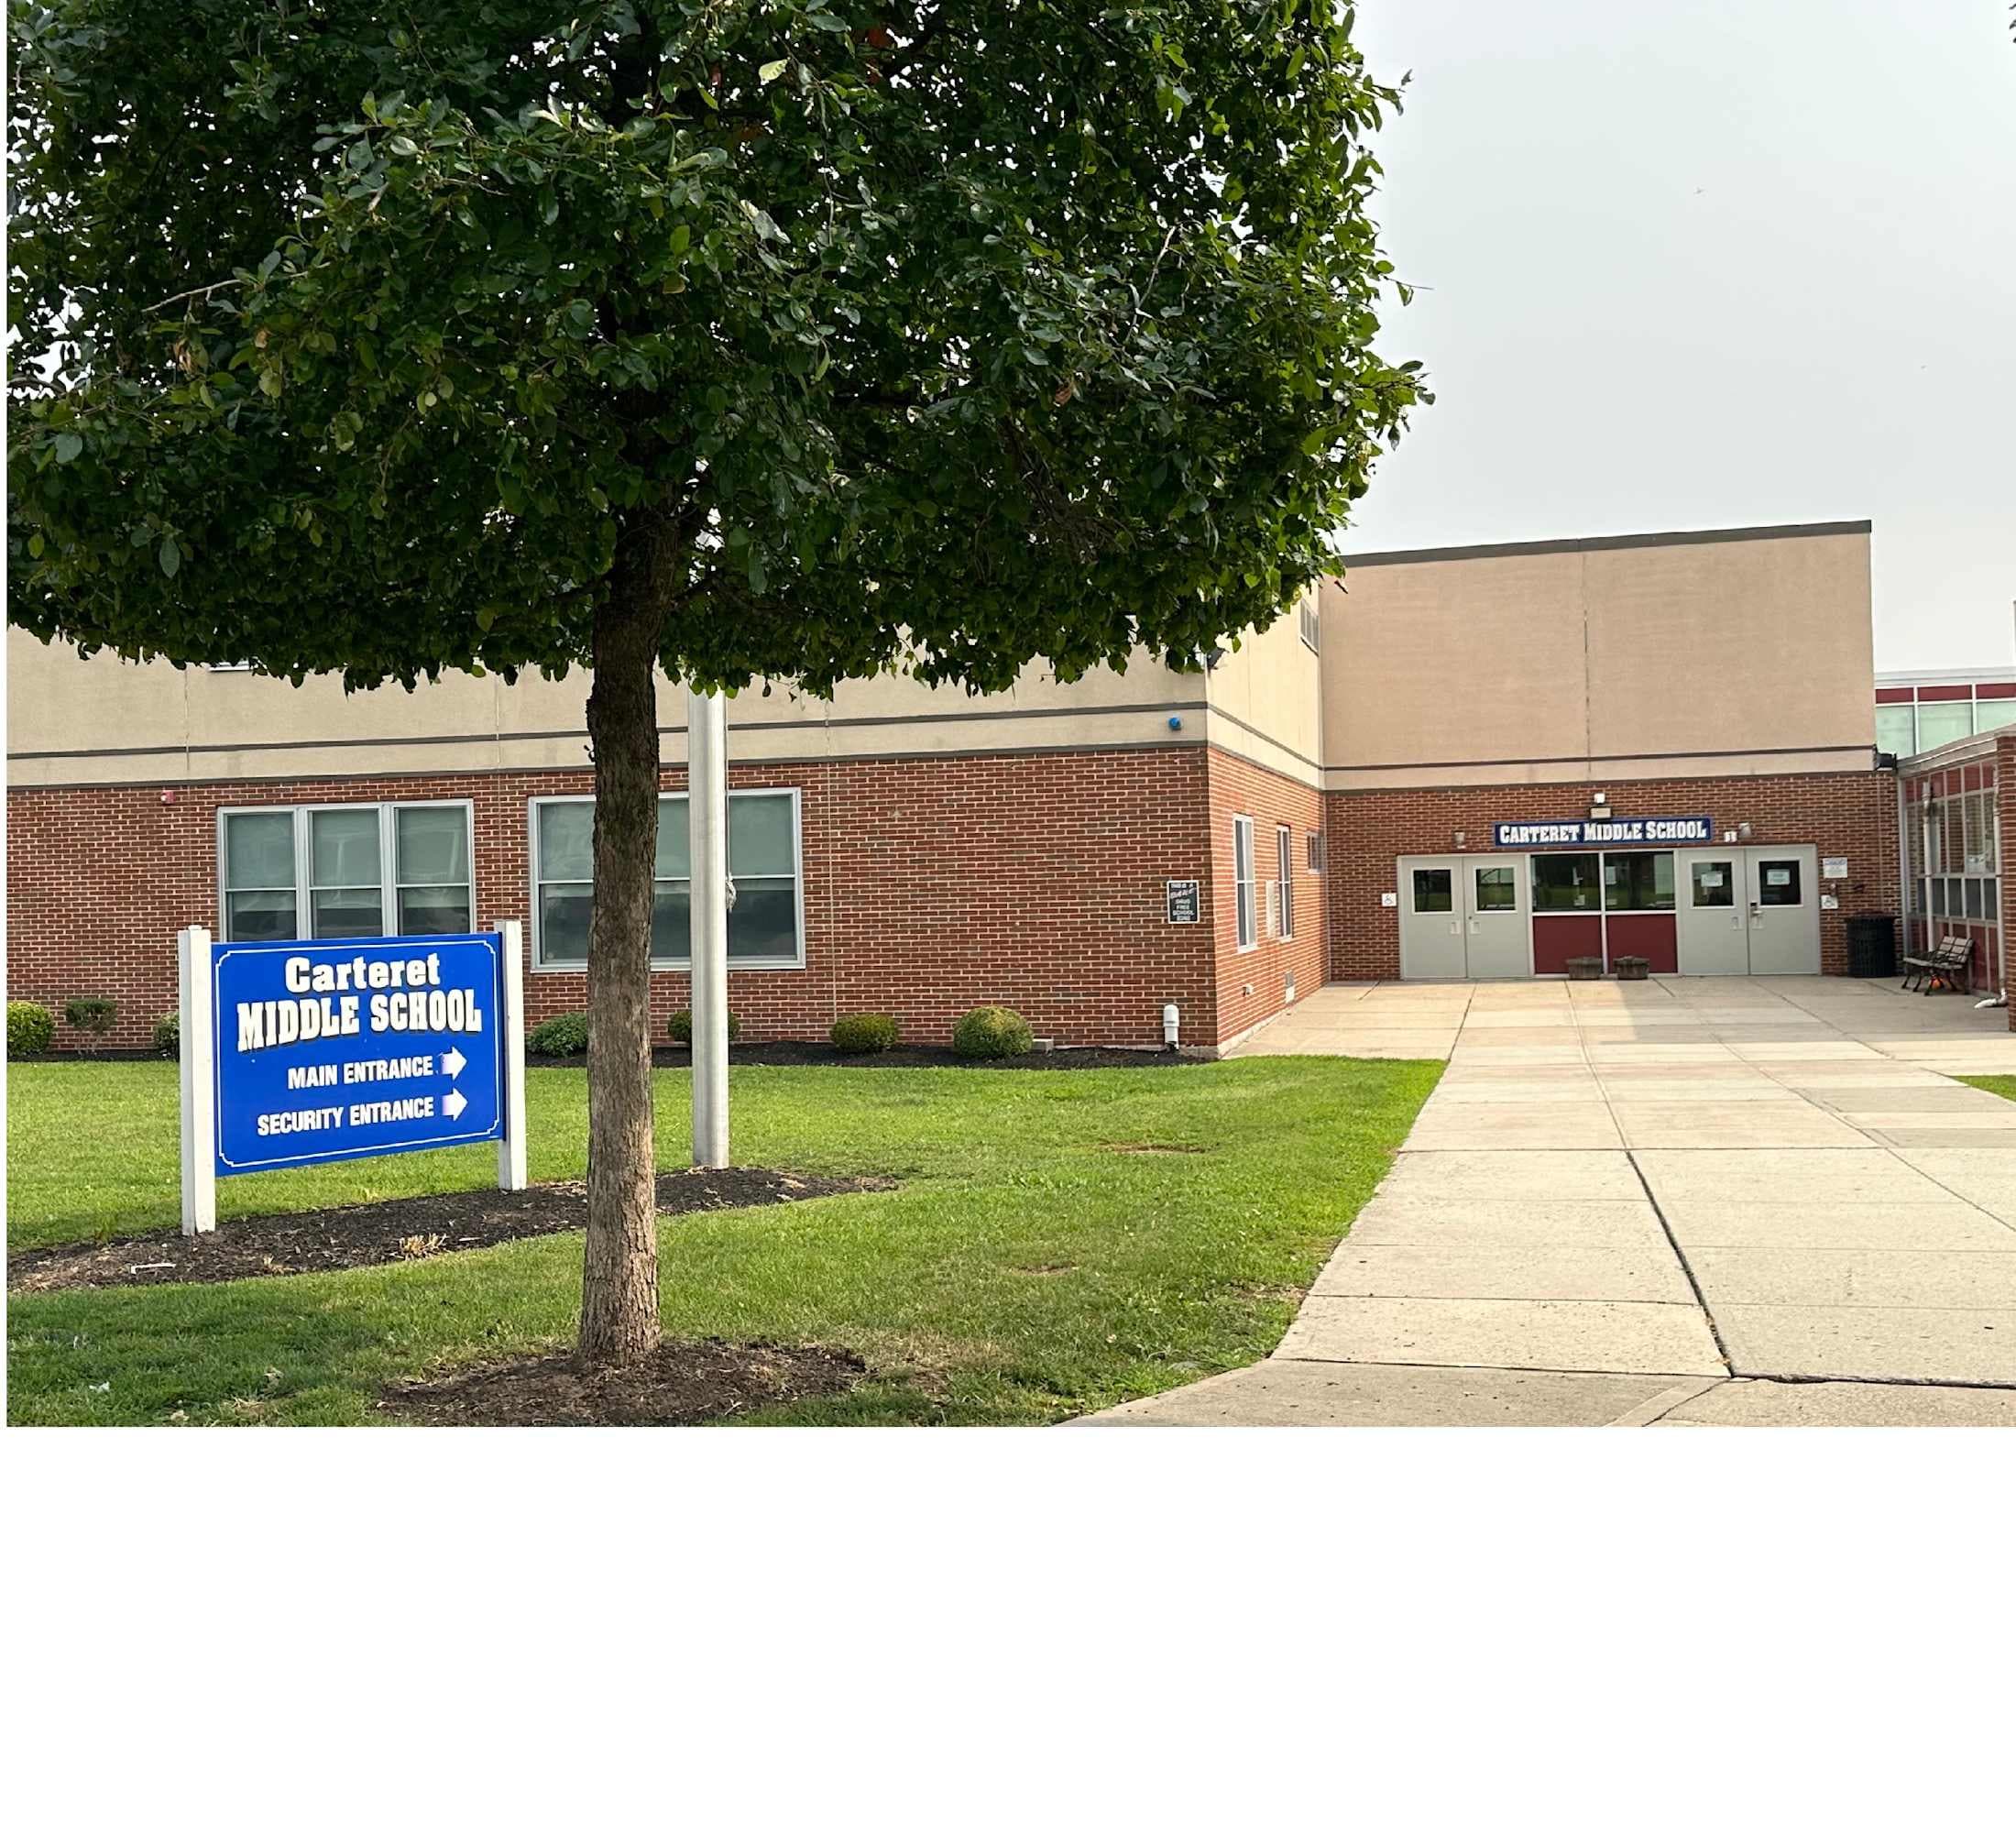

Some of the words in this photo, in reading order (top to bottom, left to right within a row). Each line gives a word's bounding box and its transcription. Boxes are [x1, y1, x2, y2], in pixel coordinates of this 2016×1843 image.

[1499, 824, 1580, 844] CARTERET
[1583, 822, 1643, 842] MIDDLE
[1645, 820, 1707, 840] SCHOOL
[285, 952, 441, 993] Carteret
[236, 995, 360, 1052] MIDDLE
[370, 989, 483, 1032] SCHOOL
[288, 1064, 338, 1090] MAIN
[343, 1055, 433, 1084] ENTRANCE
[257, 1106, 345, 1136] SECURITY
[349, 1096, 434, 1127] ENTRANCE
